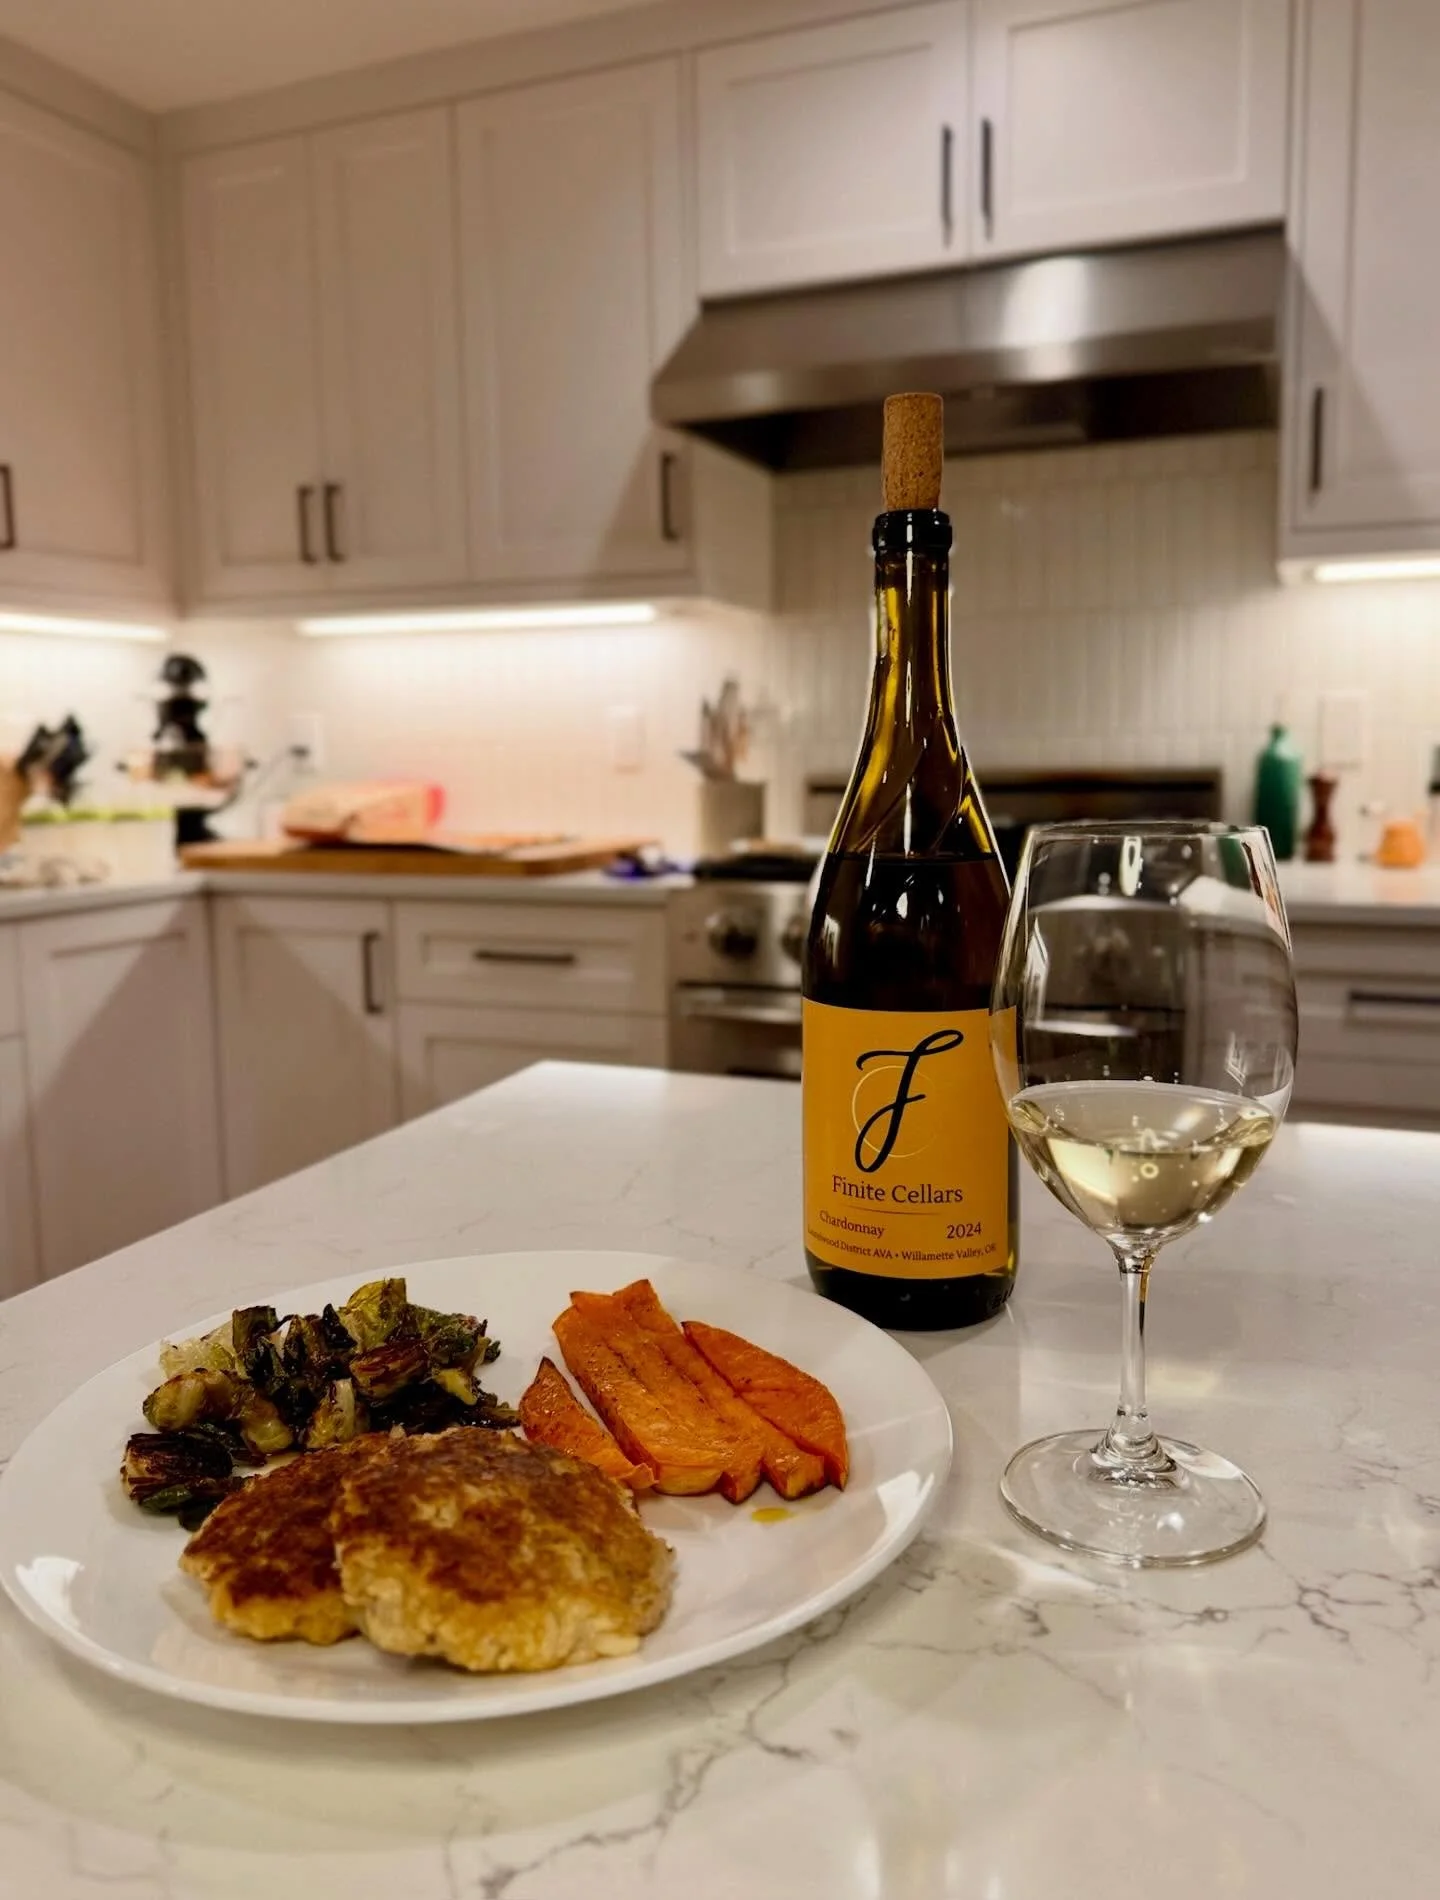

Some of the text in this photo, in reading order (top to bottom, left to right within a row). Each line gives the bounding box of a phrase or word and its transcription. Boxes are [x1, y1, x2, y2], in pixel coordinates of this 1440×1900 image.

[832, 1175, 964, 1204] Finite Cellars
[819, 1209, 982, 1240] Chardonnay 2024
[840, 1240, 871, 1257] District
[873, 1248, 893, 1260] AVA
[901, 1250, 954, 1262] Willamette
[955, 1247, 984, 1259] Valley,
